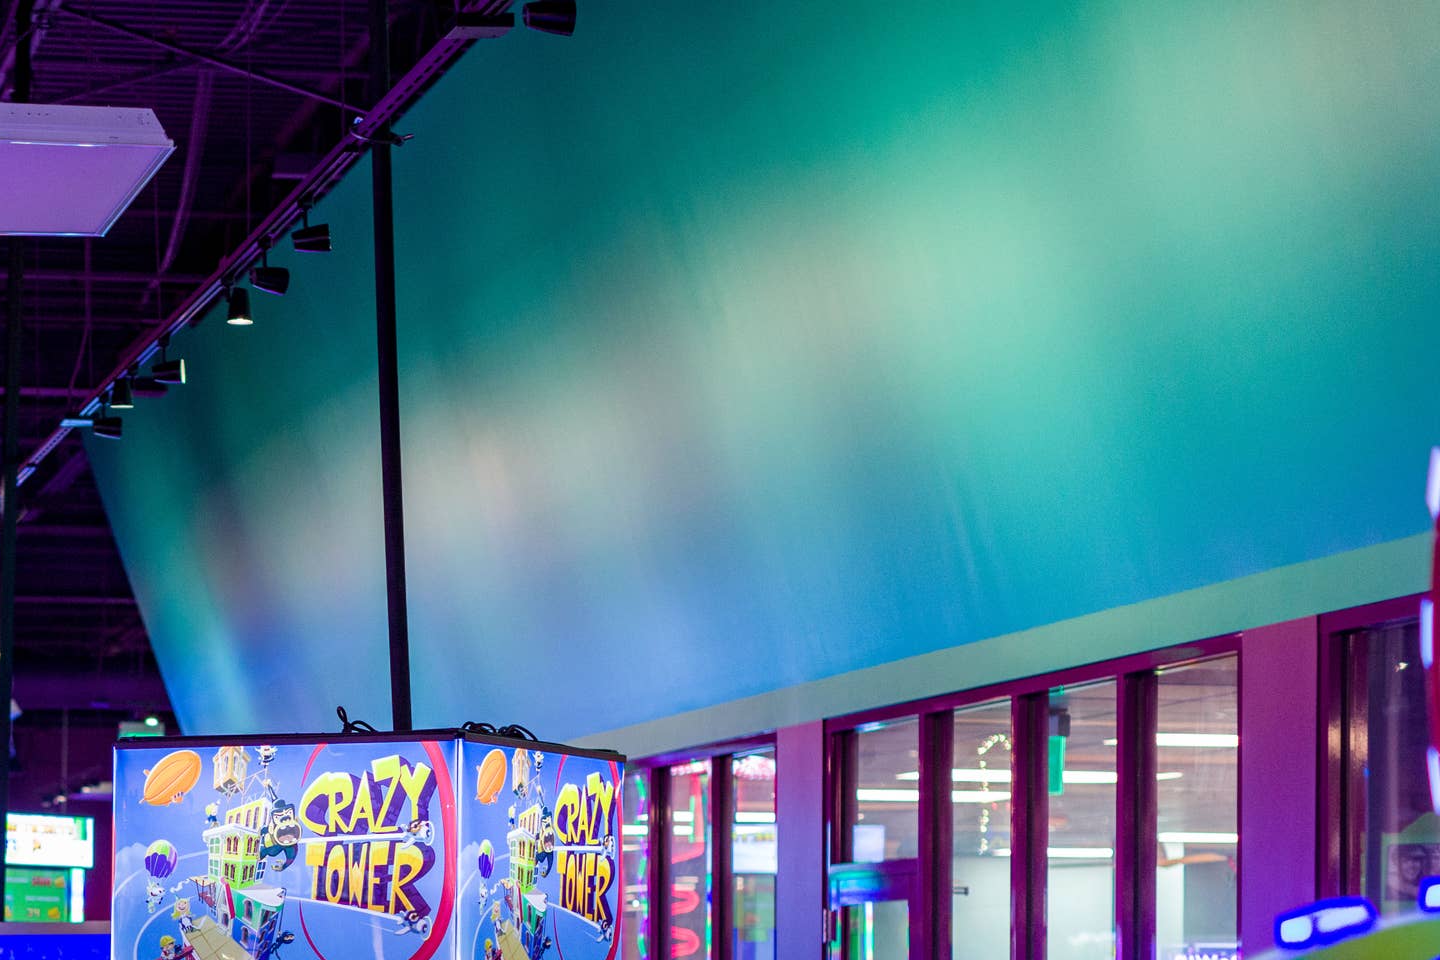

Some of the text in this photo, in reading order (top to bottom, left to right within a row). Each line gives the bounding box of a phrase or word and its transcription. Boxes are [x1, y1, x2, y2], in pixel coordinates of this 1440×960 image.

[299, 755, 436, 836] CRAZY
[554, 771, 615, 846] CRAZY
[305, 841, 433, 916] TOWER
[556, 851, 613, 923] TOWER
